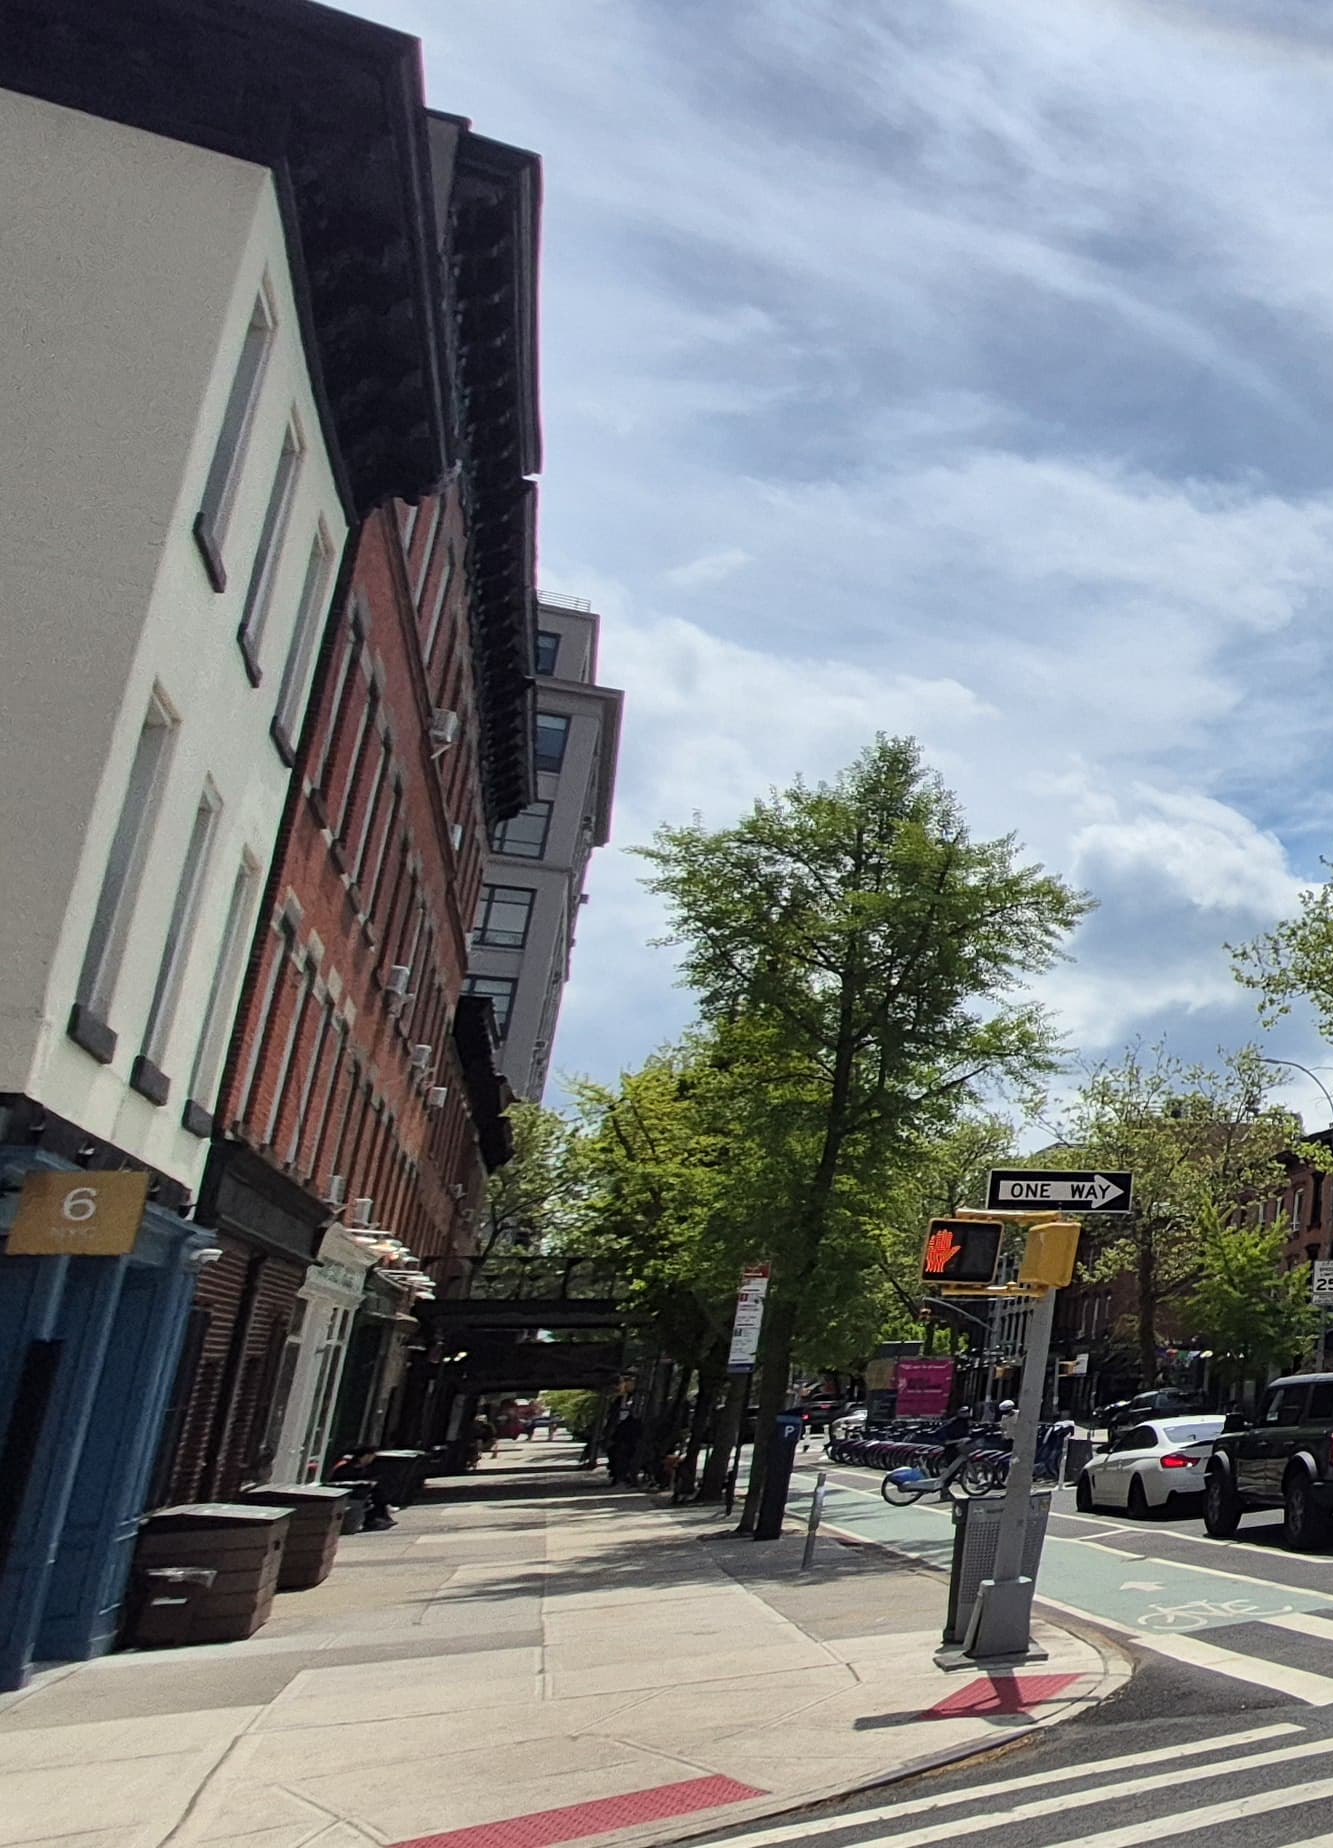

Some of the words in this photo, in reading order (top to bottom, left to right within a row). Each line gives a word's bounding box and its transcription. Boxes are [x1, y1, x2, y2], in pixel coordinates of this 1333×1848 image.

[1011, 1183, 1051, 1199] ONE
[1071, 1184, 1111, 1199] WAY
[63, 1187, 97, 1221] 6
[784, 1425, 795, 1438] P
